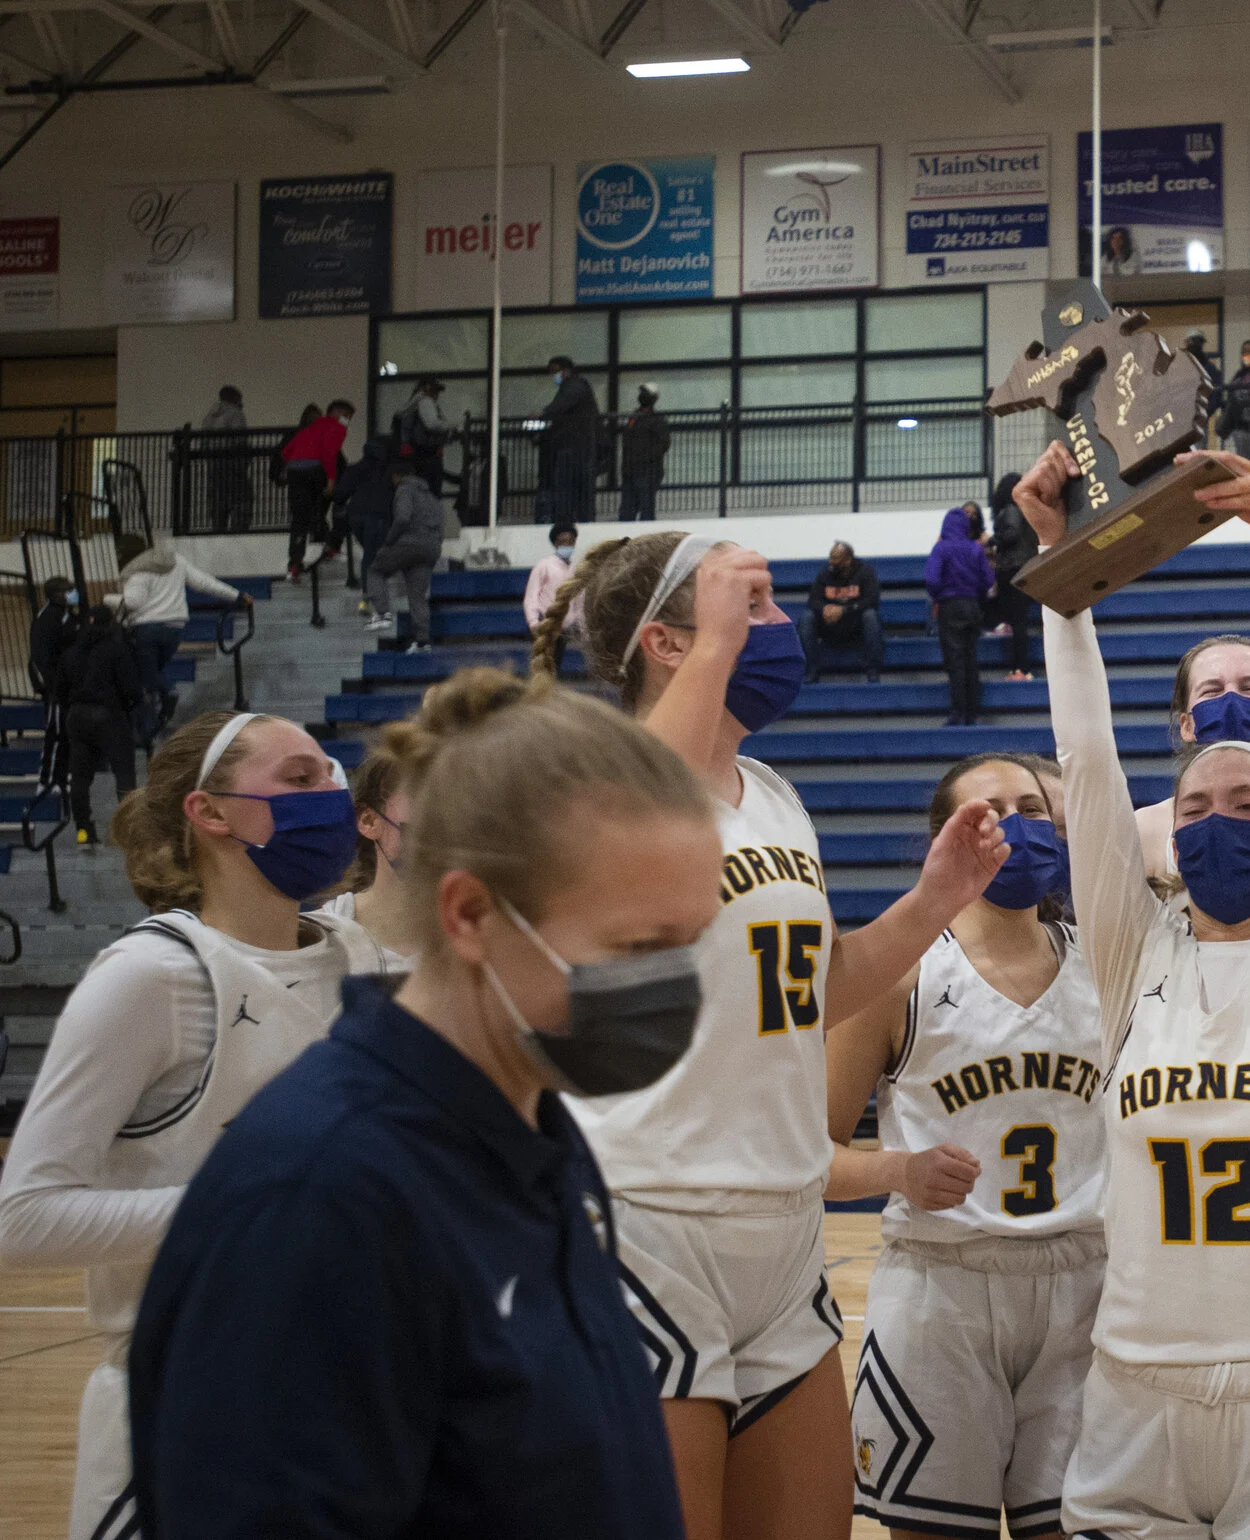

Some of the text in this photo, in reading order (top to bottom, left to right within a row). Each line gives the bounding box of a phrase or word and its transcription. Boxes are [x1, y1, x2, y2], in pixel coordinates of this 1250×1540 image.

[918, 153, 1041, 176] MainStreet
[593, 176, 634, 197] Real
[676, 188, 696, 203] #1
[984, 178, 1042, 192] Services
[1084, 174, 1217, 197] Tusted care.
[599, 193, 653, 211] Estate
[584, 209, 623, 227] One
[773, 205, 821, 229] Gym
[910, 213, 945, 229] Chad
[425, 213, 542, 262] meijer
[766, 225, 855, 243] America
[578, 252, 711, 277] Matt Dejanovich
[1134, 411, 1174, 445] 2021
[1066, 412, 1110, 510] CHAMPION
[747, 920, 823, 1037] 15
[930, 1051, 1101, 1116] HORNETS
[1000, 1122, 1060, 1219] 3
